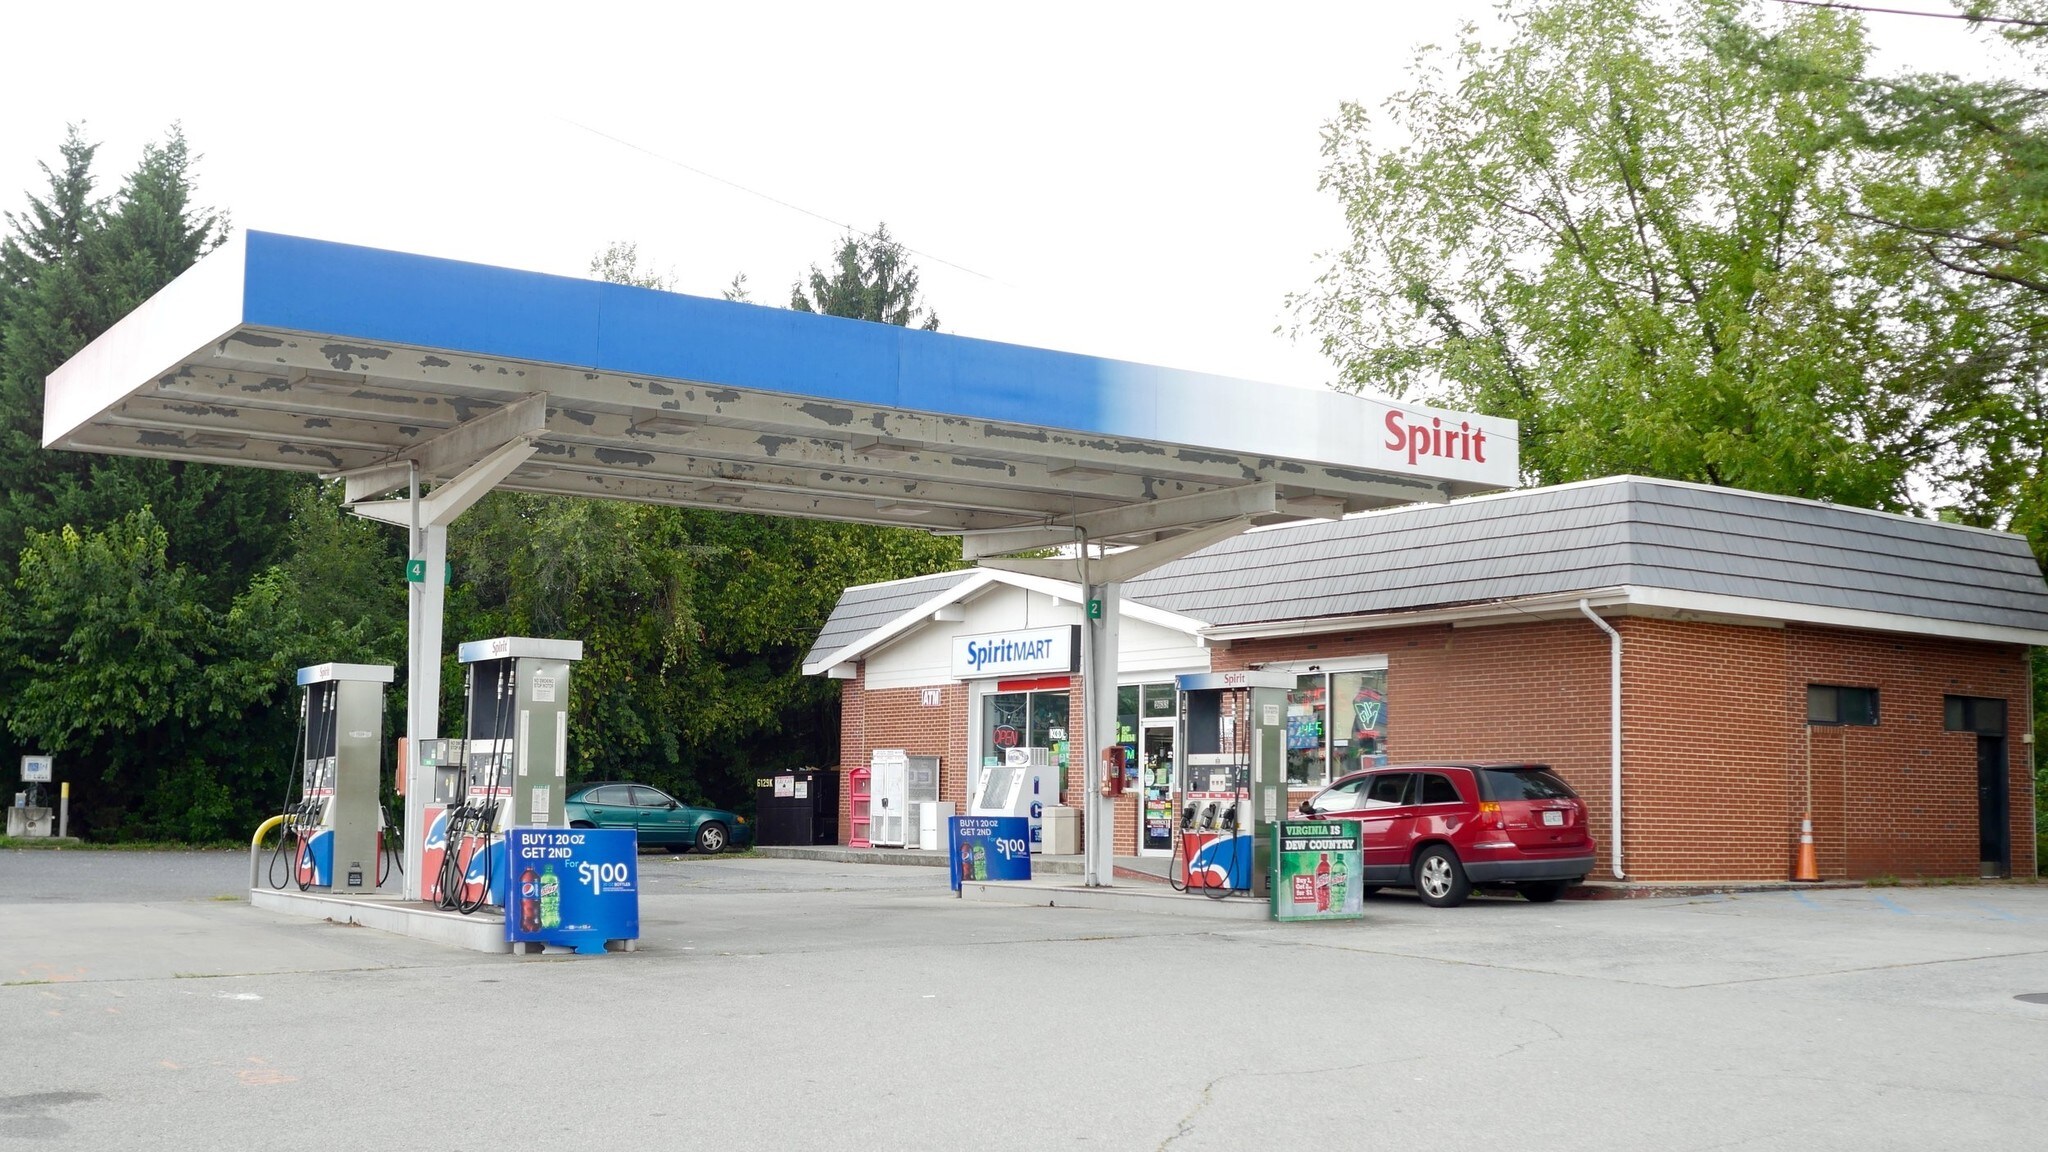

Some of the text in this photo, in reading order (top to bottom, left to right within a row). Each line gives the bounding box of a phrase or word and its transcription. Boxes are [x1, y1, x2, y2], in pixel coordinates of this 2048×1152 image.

[1385, 410, 1486, 465] Spirit
[412, 564, 421, 576] 4
[1091, 603, 1098, 614] 2
[492, 641, 508, 656] Spirit
[967, 639, 1052, 671] SpiritMART
[1224, 673, 1246, 686] Spirit
[922, 690, 940, 706] ATM
[993, 729, 1018, 746] OPEN
[1285, 825, 1341, 835] VIRGINIA IS
[521, 834, 585, 845] BUY 1 20 OZ
[1285, 840, 1355, 850] DEW COUNTRY
[521, 847, 572, 858] GET 2ND
[565, 859, 579, 868] For
